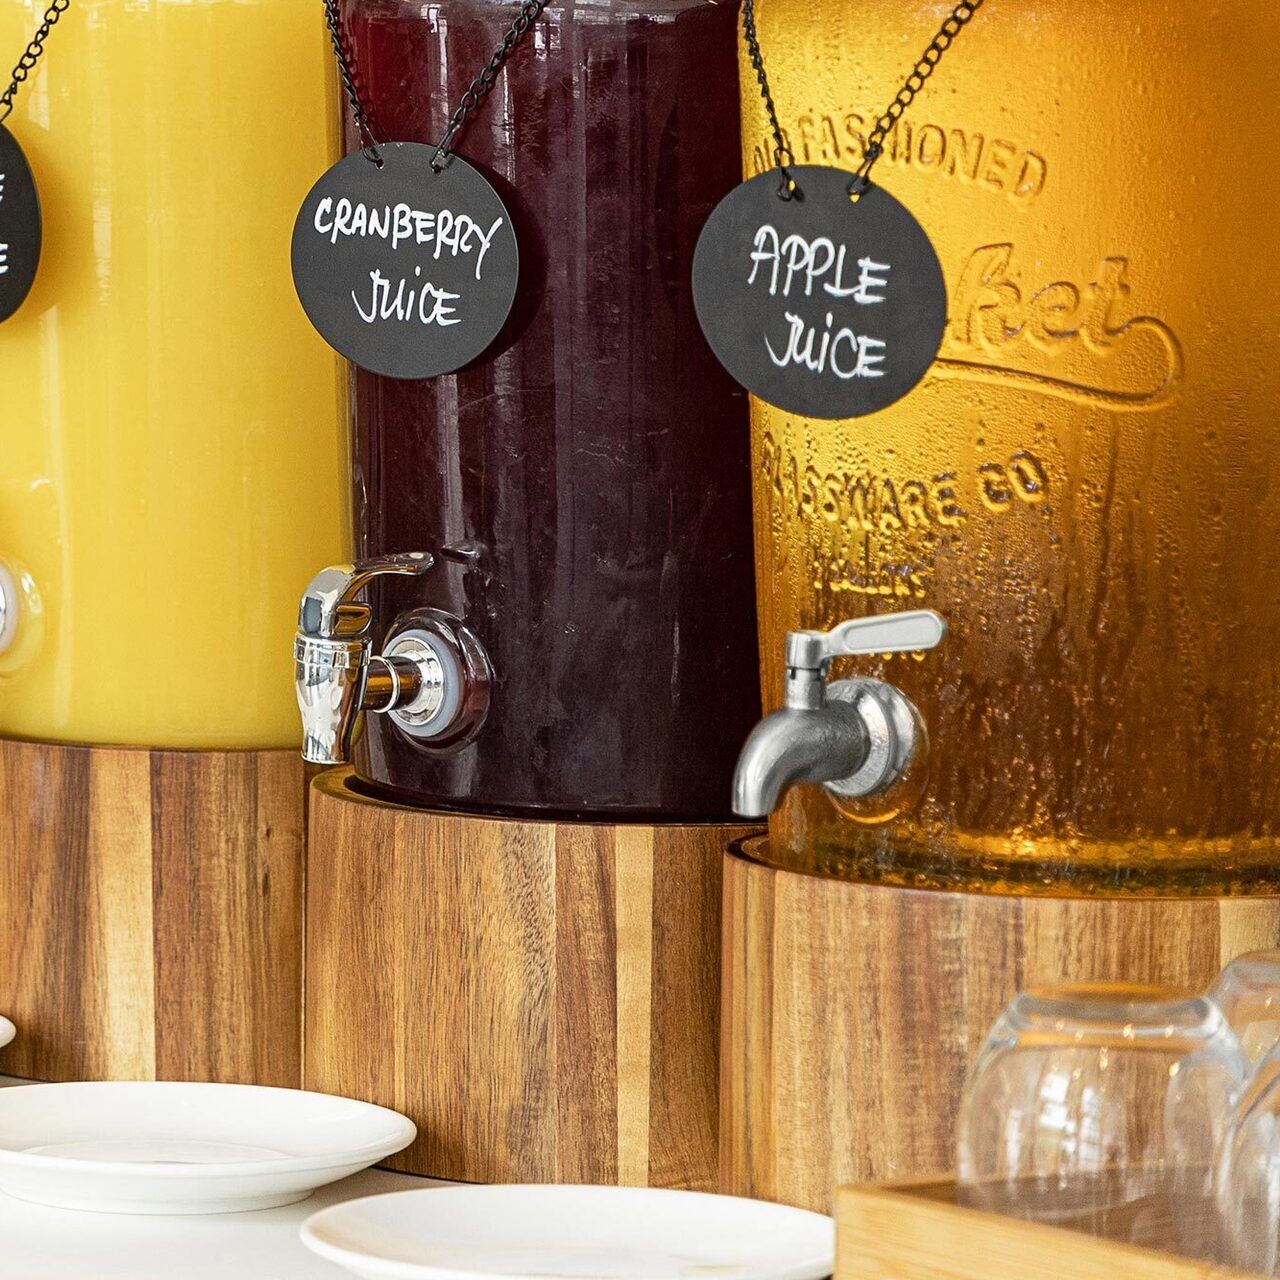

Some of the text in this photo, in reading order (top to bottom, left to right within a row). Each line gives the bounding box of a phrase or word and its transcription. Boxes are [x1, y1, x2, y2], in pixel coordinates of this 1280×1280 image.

[798, 113, 1048, 198] FASHIONED
[314, 197, 503, 280] CRANBERRY
[747, 224, 891, 304] APPLE
